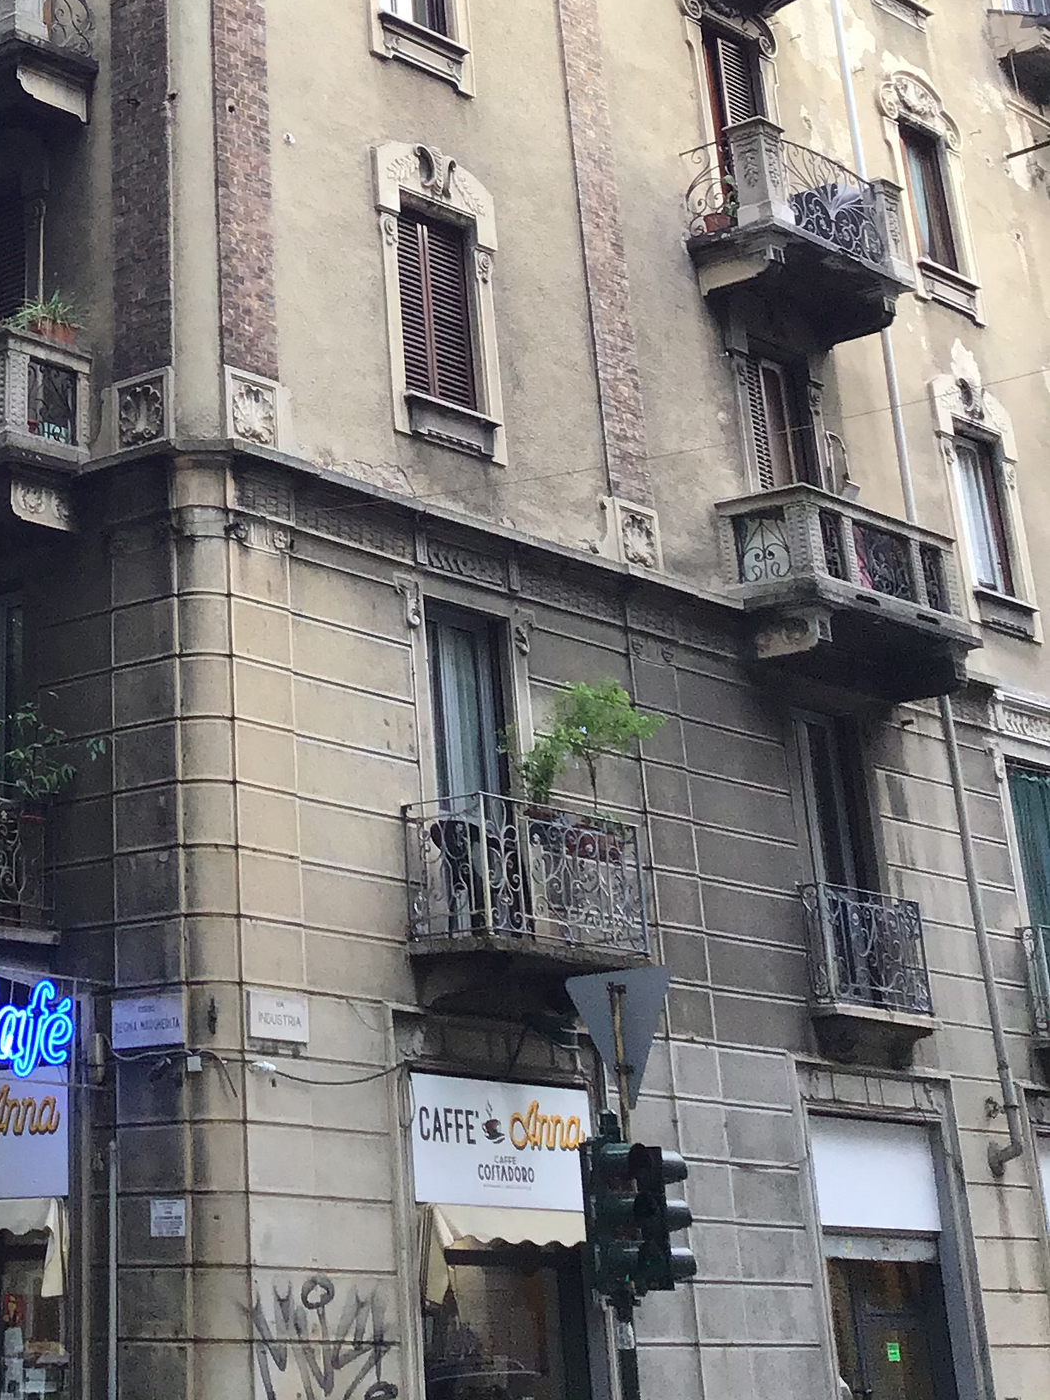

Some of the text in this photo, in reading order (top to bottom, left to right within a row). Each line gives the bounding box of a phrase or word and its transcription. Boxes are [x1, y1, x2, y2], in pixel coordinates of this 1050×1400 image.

[140, 1016, 181, 1031] MARGHERITA
[258, 1011, 302, 1028] INDUSTRIA
[419, 1100, 585, 1151] CAFFE' Anna
[478, 1163, 535, 1183] COSTADORO
